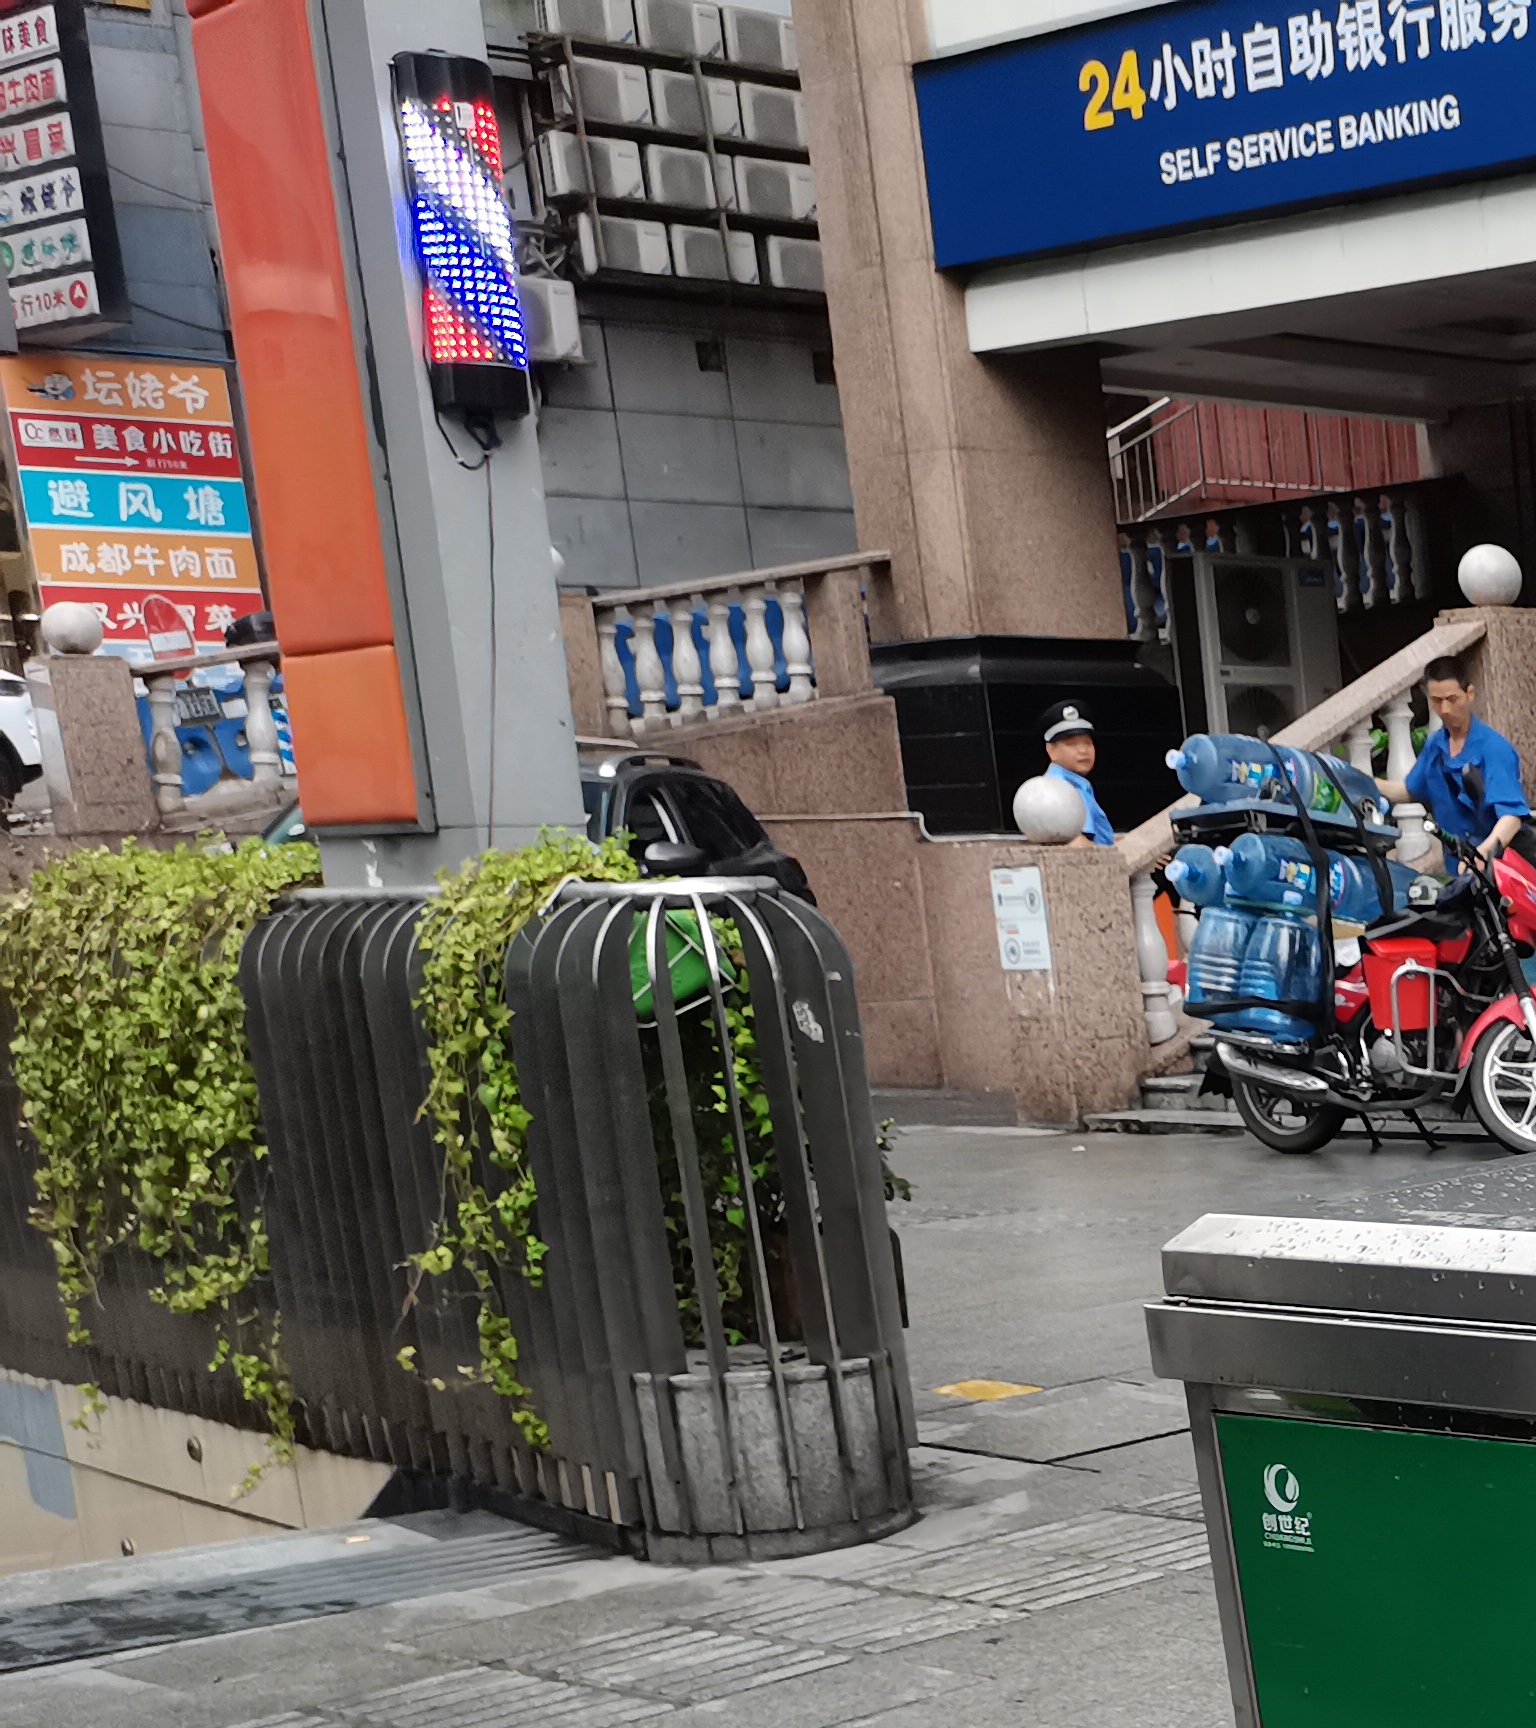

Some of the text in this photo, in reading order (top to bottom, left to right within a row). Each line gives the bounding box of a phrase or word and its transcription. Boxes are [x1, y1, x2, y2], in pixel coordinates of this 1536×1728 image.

[1159, 94, 1461, 185] SELF SERVICE BANKING
[48, 479, 226, 527] 避风塘
[60, 542, 238, 580] 成都牛肉面
[1261, 1512, 1311, 1536] 创世纪
